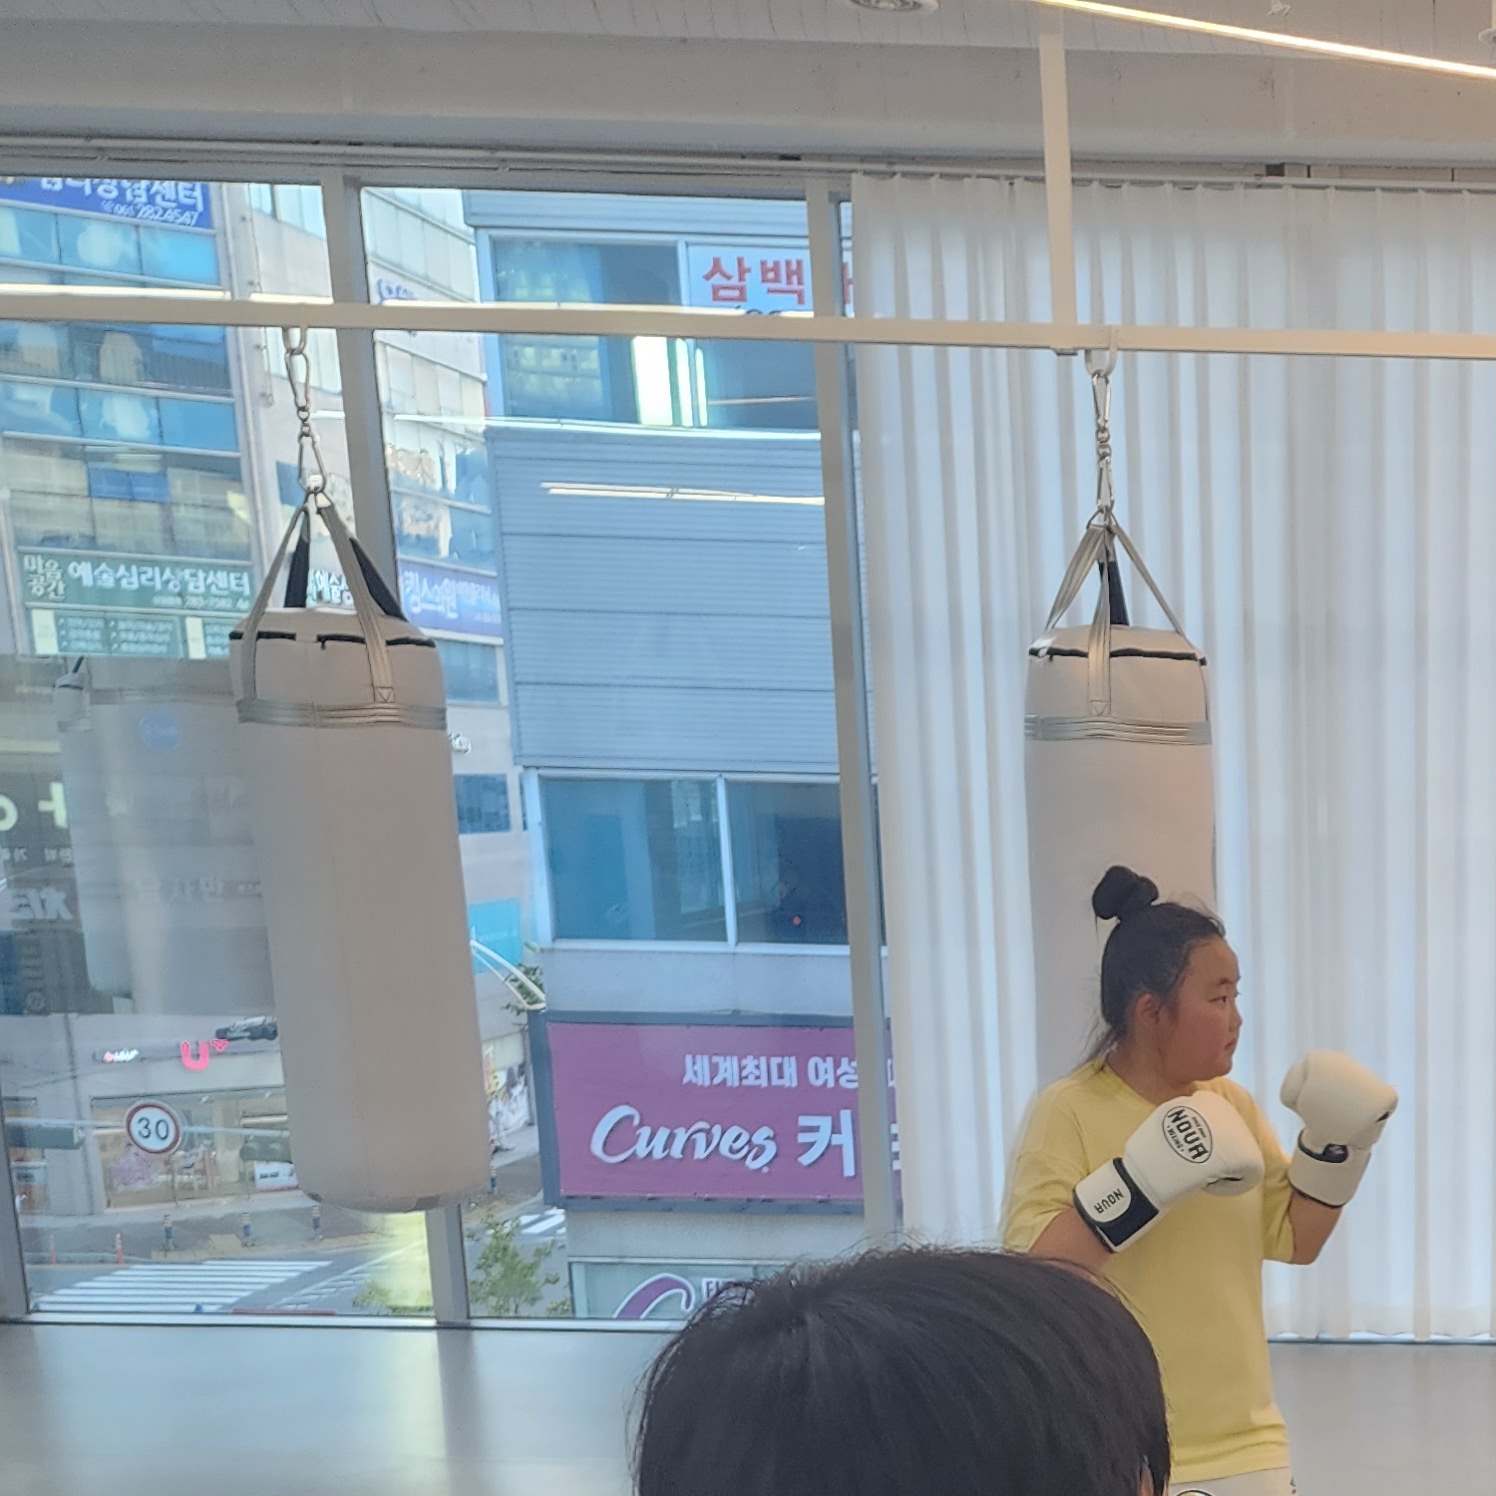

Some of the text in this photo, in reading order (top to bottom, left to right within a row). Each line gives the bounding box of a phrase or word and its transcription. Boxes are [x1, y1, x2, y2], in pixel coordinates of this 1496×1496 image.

[702, 256, 853, 305] 삼백
[68, 561, 250, 596] 예술심리상담센터
[682, 1054, 797, 1088] 세계최대
[137, 1117, 169, 1140] 30
[590, 1104, 777, 1170] Curves
